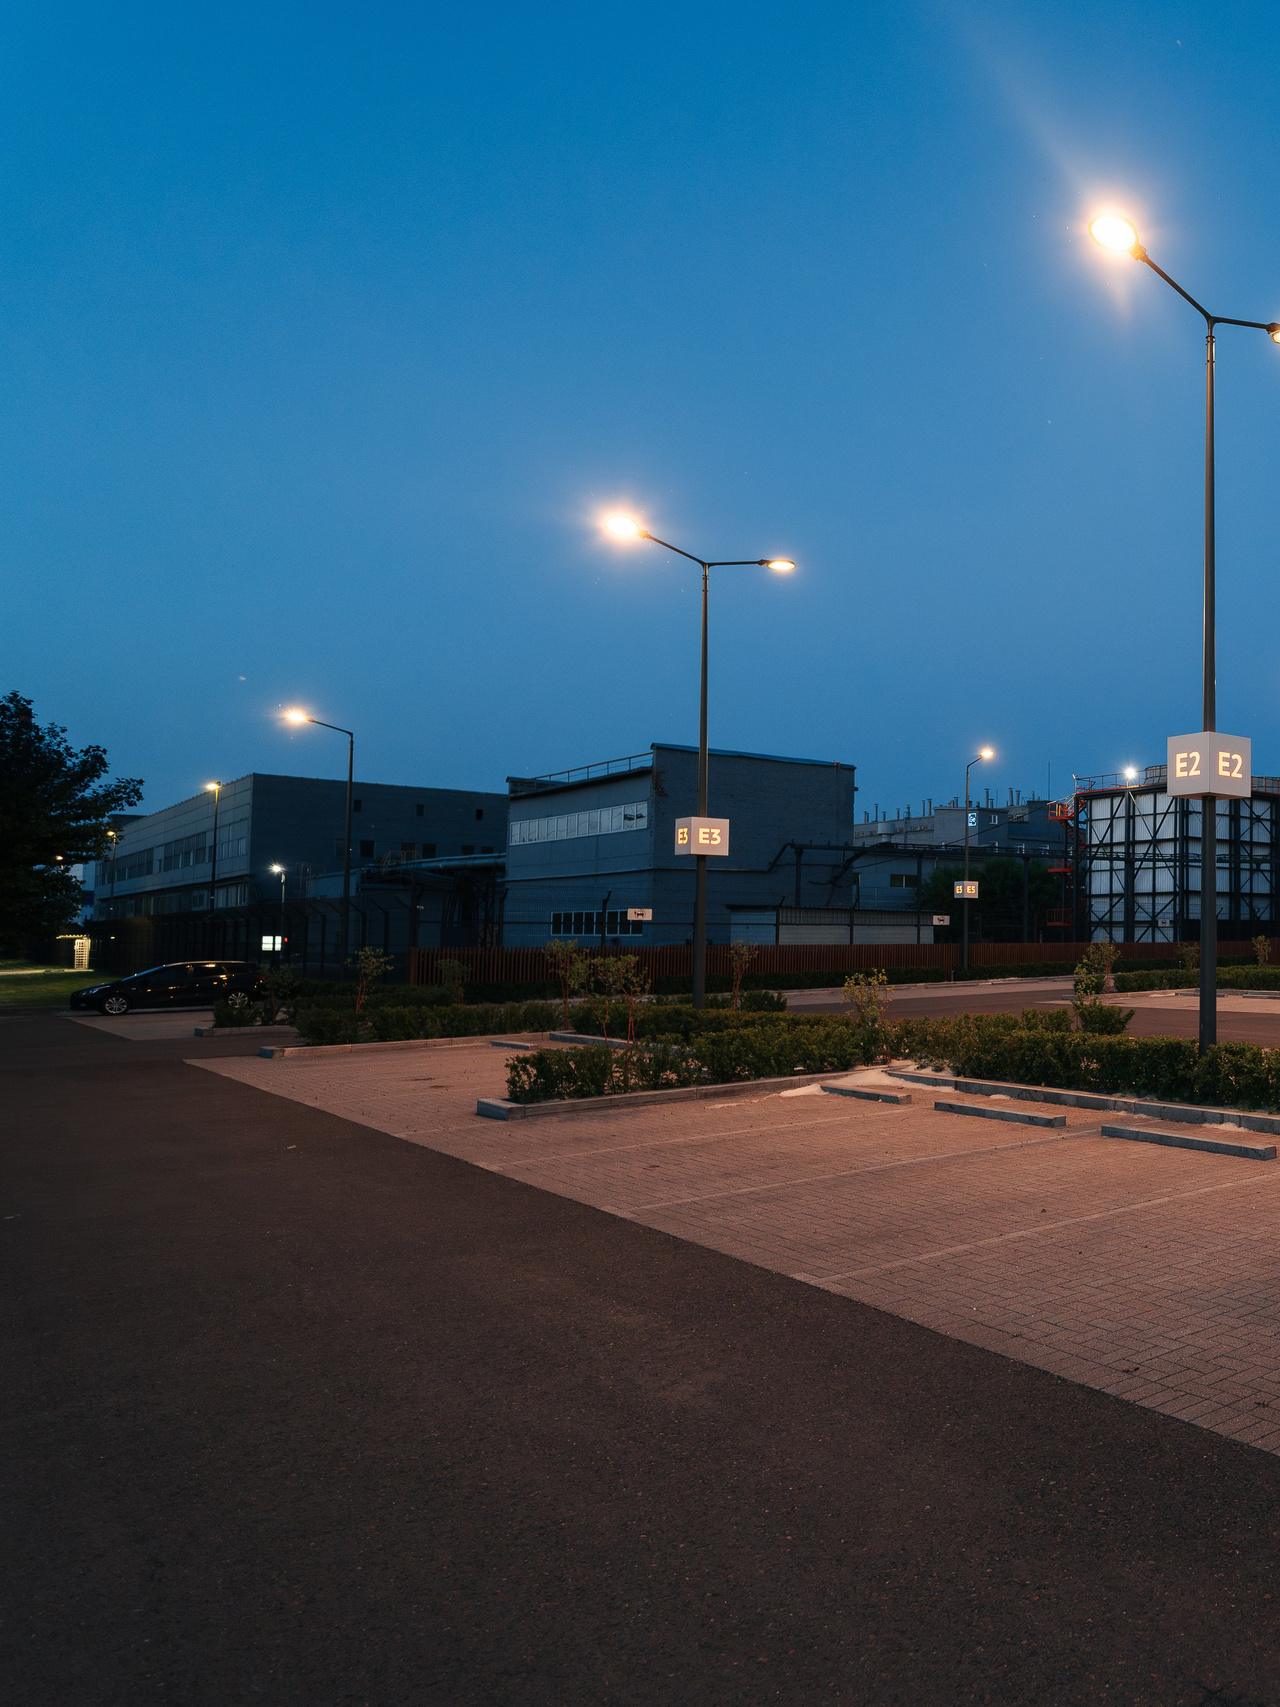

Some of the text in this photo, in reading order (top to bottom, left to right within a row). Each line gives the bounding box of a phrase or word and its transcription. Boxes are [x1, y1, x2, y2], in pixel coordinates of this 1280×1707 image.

[1176, 751, 1201, 778] E2
[1218, 751, 1243, 779] E2
[678, 828, 688, 844] E3
[698, 828, 721, 844] E3
[956, 886, 963, 894] E5
[966, 886, 975, 894] E5
